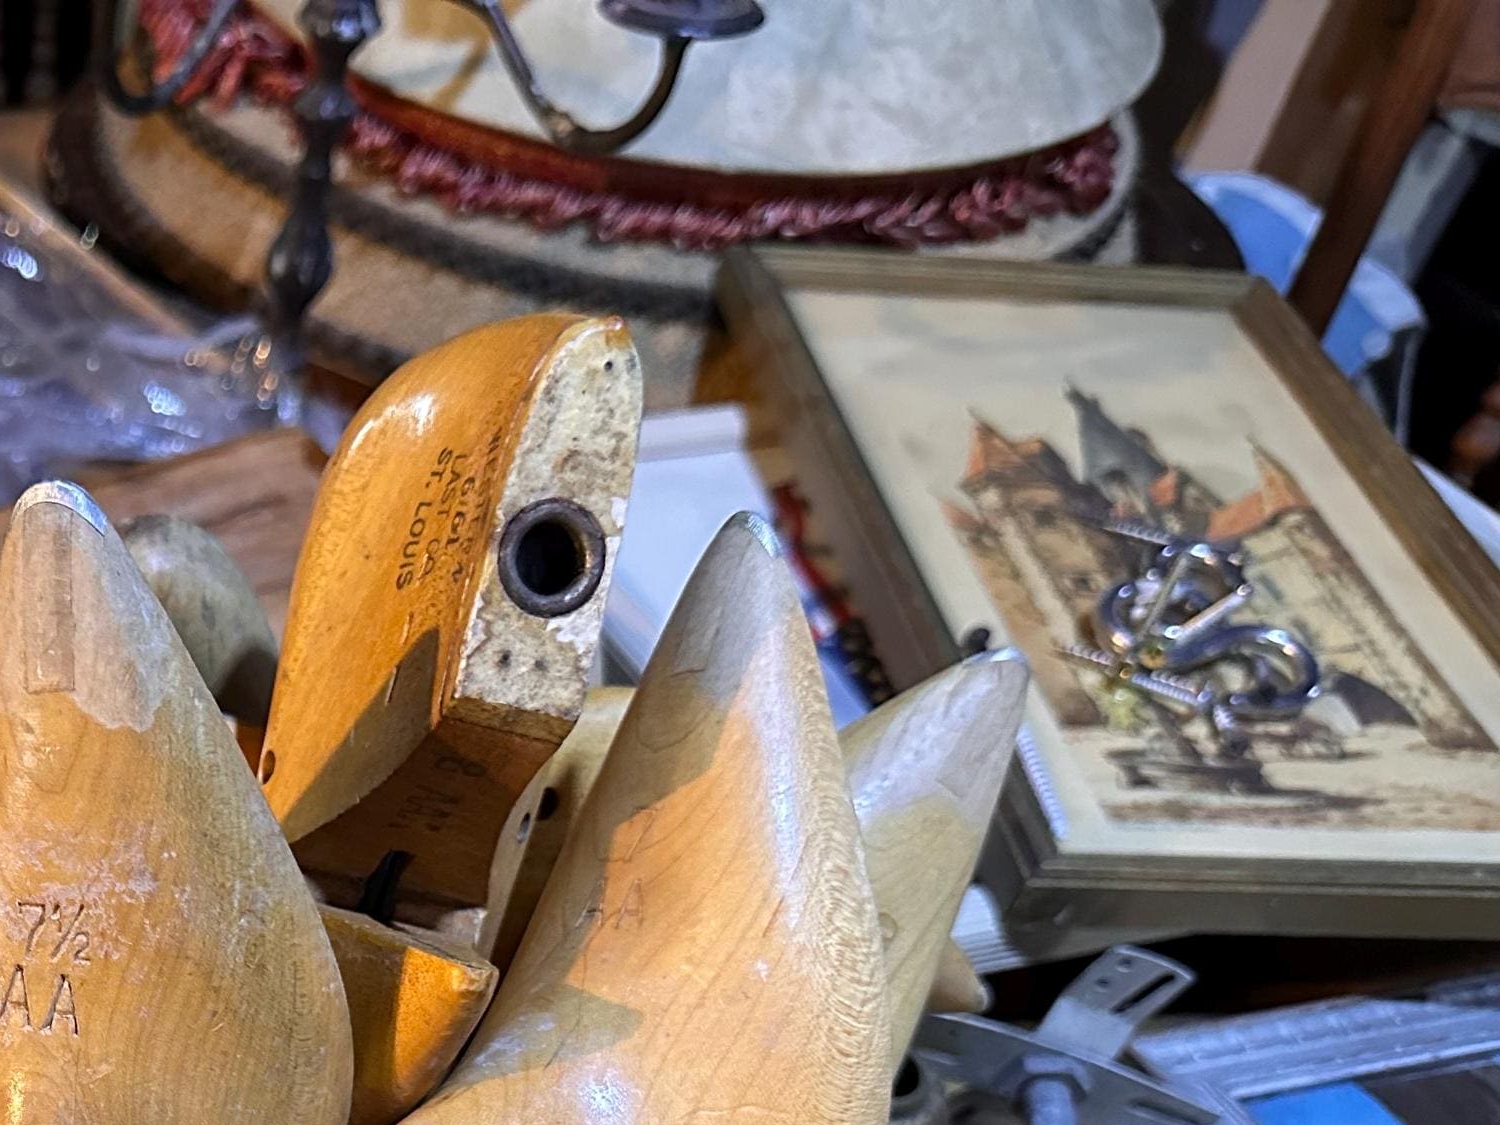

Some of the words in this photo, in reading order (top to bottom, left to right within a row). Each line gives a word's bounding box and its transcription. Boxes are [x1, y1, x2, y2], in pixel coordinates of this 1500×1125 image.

[424, 447, 453, 489] ST.
[437, 454, 467, 517] LAST
[396, 502, 432, 590] LOUIS
